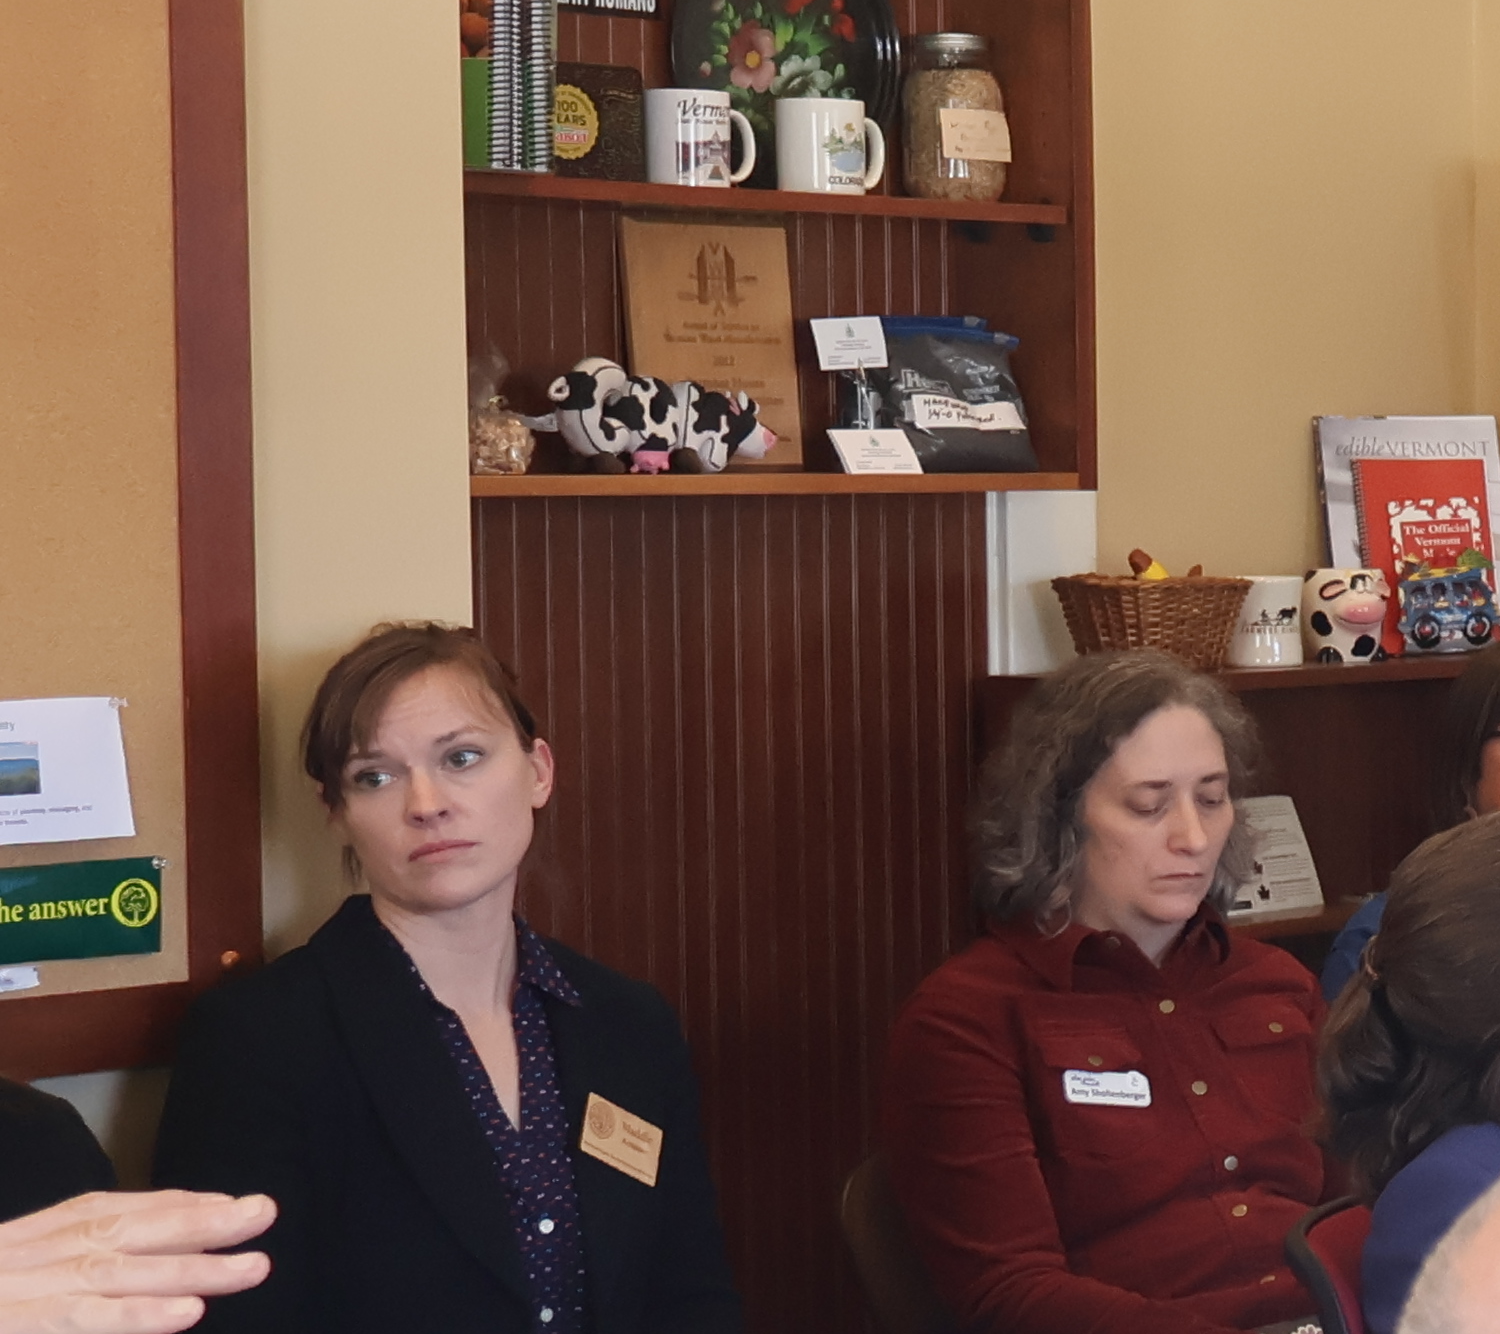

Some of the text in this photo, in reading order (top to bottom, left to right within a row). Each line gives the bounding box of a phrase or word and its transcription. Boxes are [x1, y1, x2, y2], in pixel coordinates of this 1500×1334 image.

[556, 114, 586, 126] EARS
[1403, 523, 1469, 535] The Official
[1415, 537, 1461, 547] Vermont
[29, 898, 109, 921] answer
